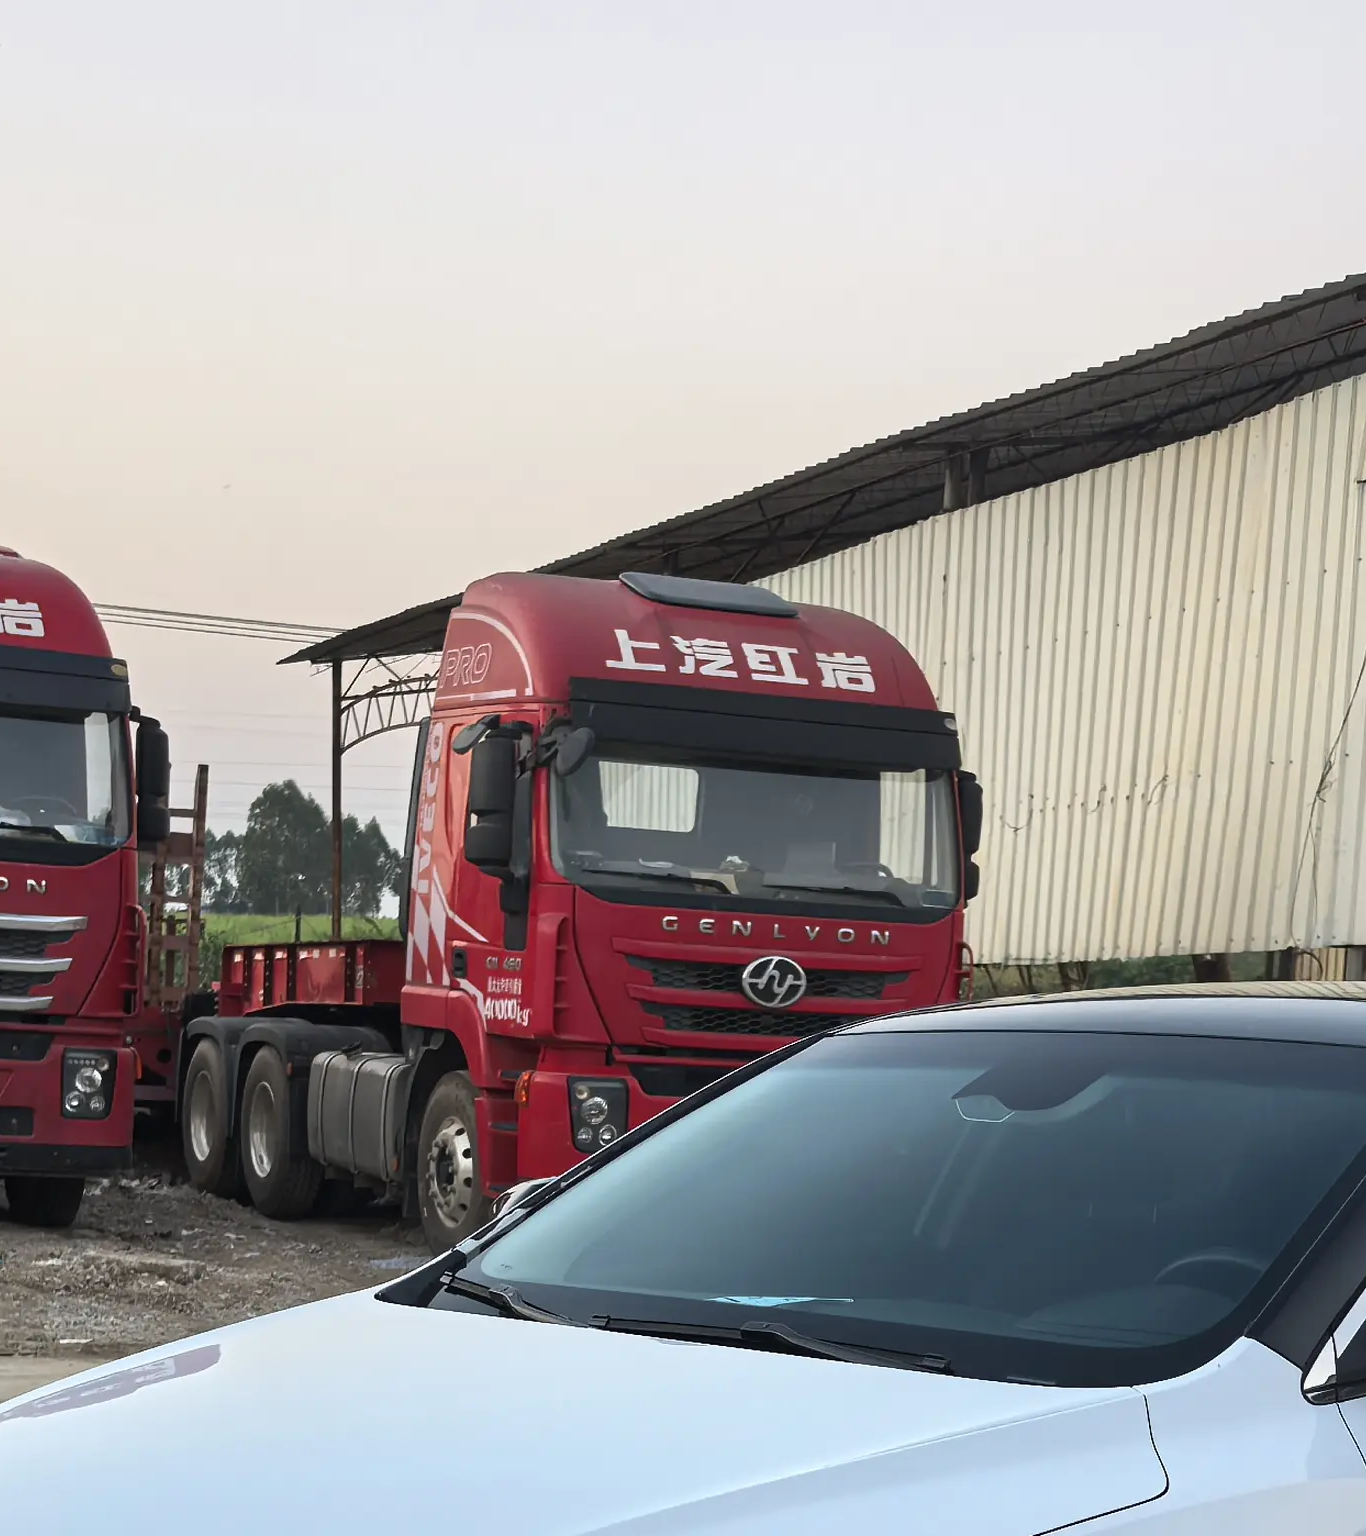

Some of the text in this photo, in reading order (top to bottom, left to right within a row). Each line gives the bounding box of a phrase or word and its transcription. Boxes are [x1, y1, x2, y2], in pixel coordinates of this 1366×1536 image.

[439, 643, 493, 689] PRO
[605, 629, 875, 693] 上汽红岩
[417, 722, 444, 895] IVECO
[662, 915, 890, 945] GENLYON
